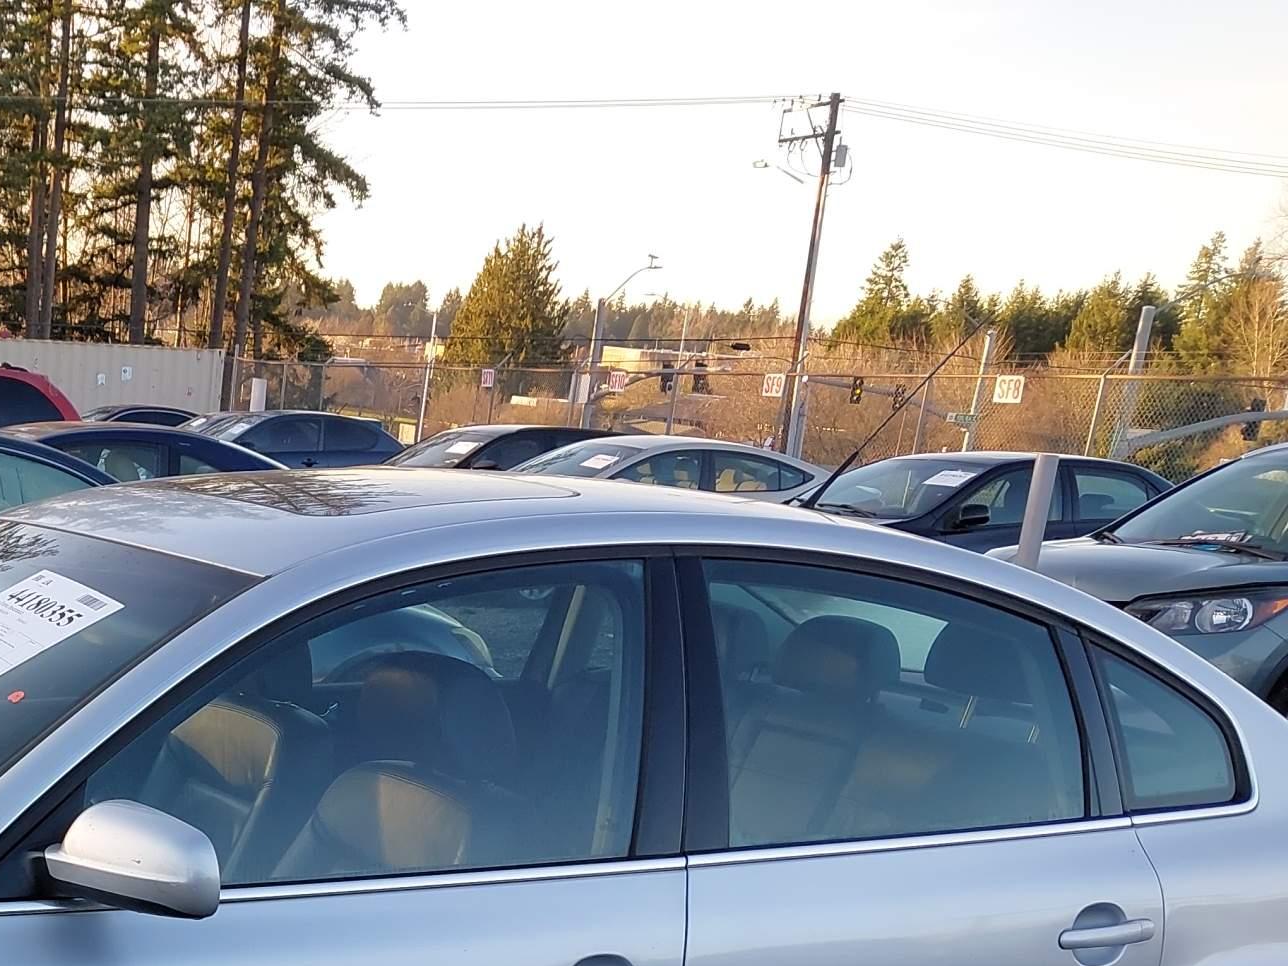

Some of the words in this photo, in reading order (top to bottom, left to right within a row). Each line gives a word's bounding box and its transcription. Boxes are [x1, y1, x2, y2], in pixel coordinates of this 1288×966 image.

[765, 376, 782, 393] SF9
[998, 379, 1021, 399] SF8
[7, 588, 83, 627] 44180355
